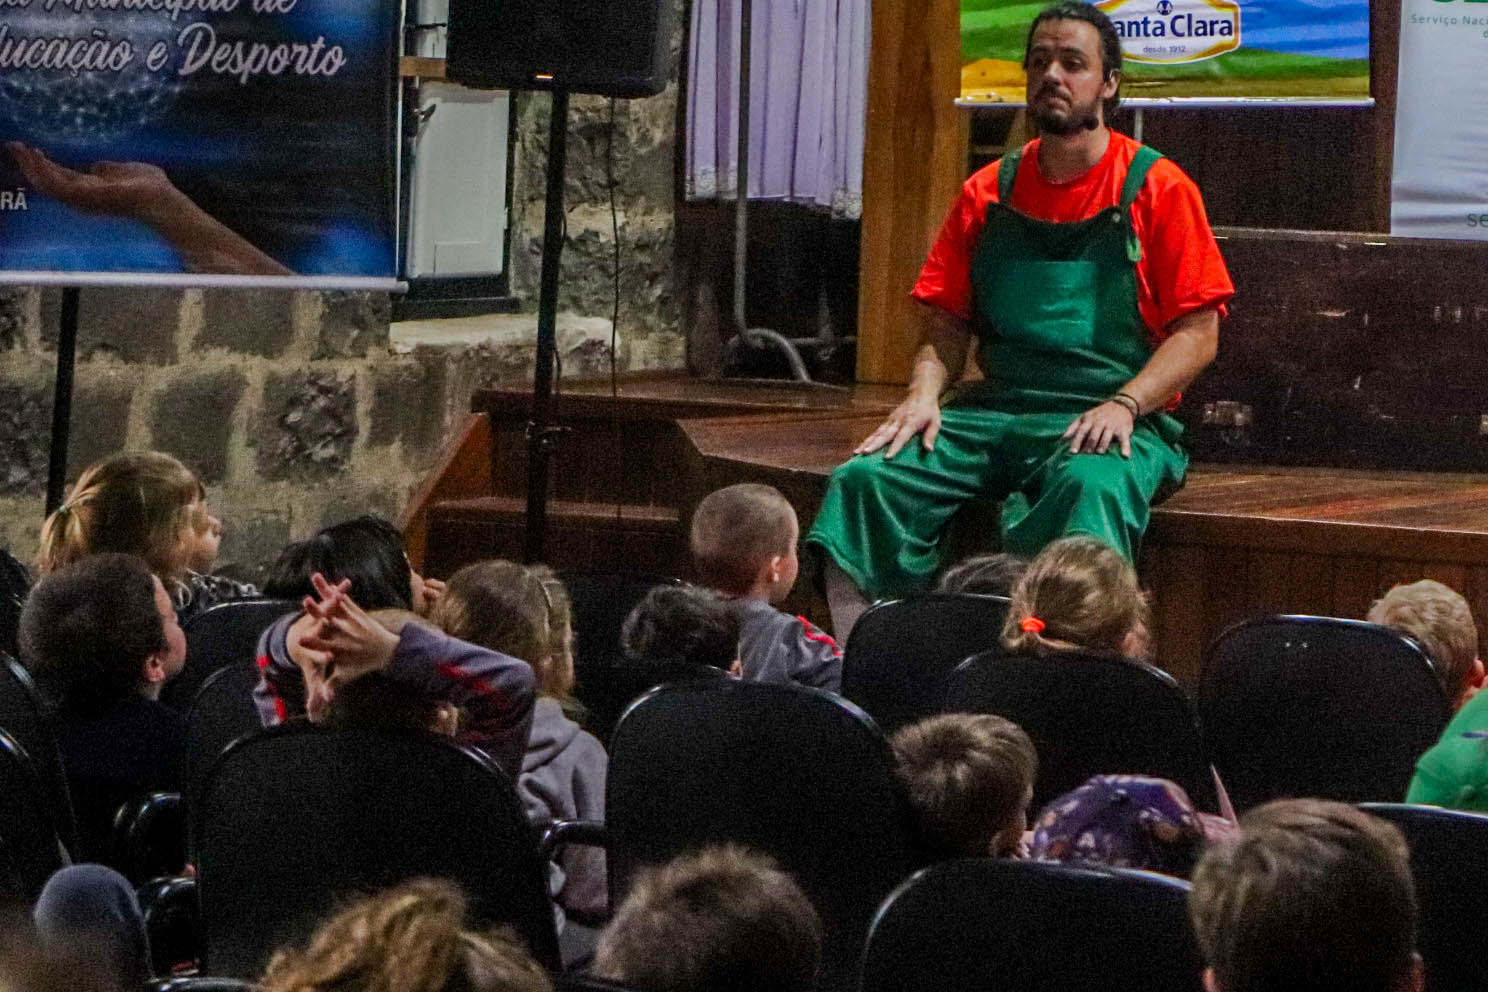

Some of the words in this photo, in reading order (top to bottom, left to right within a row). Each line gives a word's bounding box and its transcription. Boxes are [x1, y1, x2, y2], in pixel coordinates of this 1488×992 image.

[1112, 16, 1166, 38] anta
[1170, 13, 1233, 38] Clara
[1410, 14, 1457, 26] Serviço
[146, 40, 169, 73] e
[177, 22, 347, 85] Desporto
